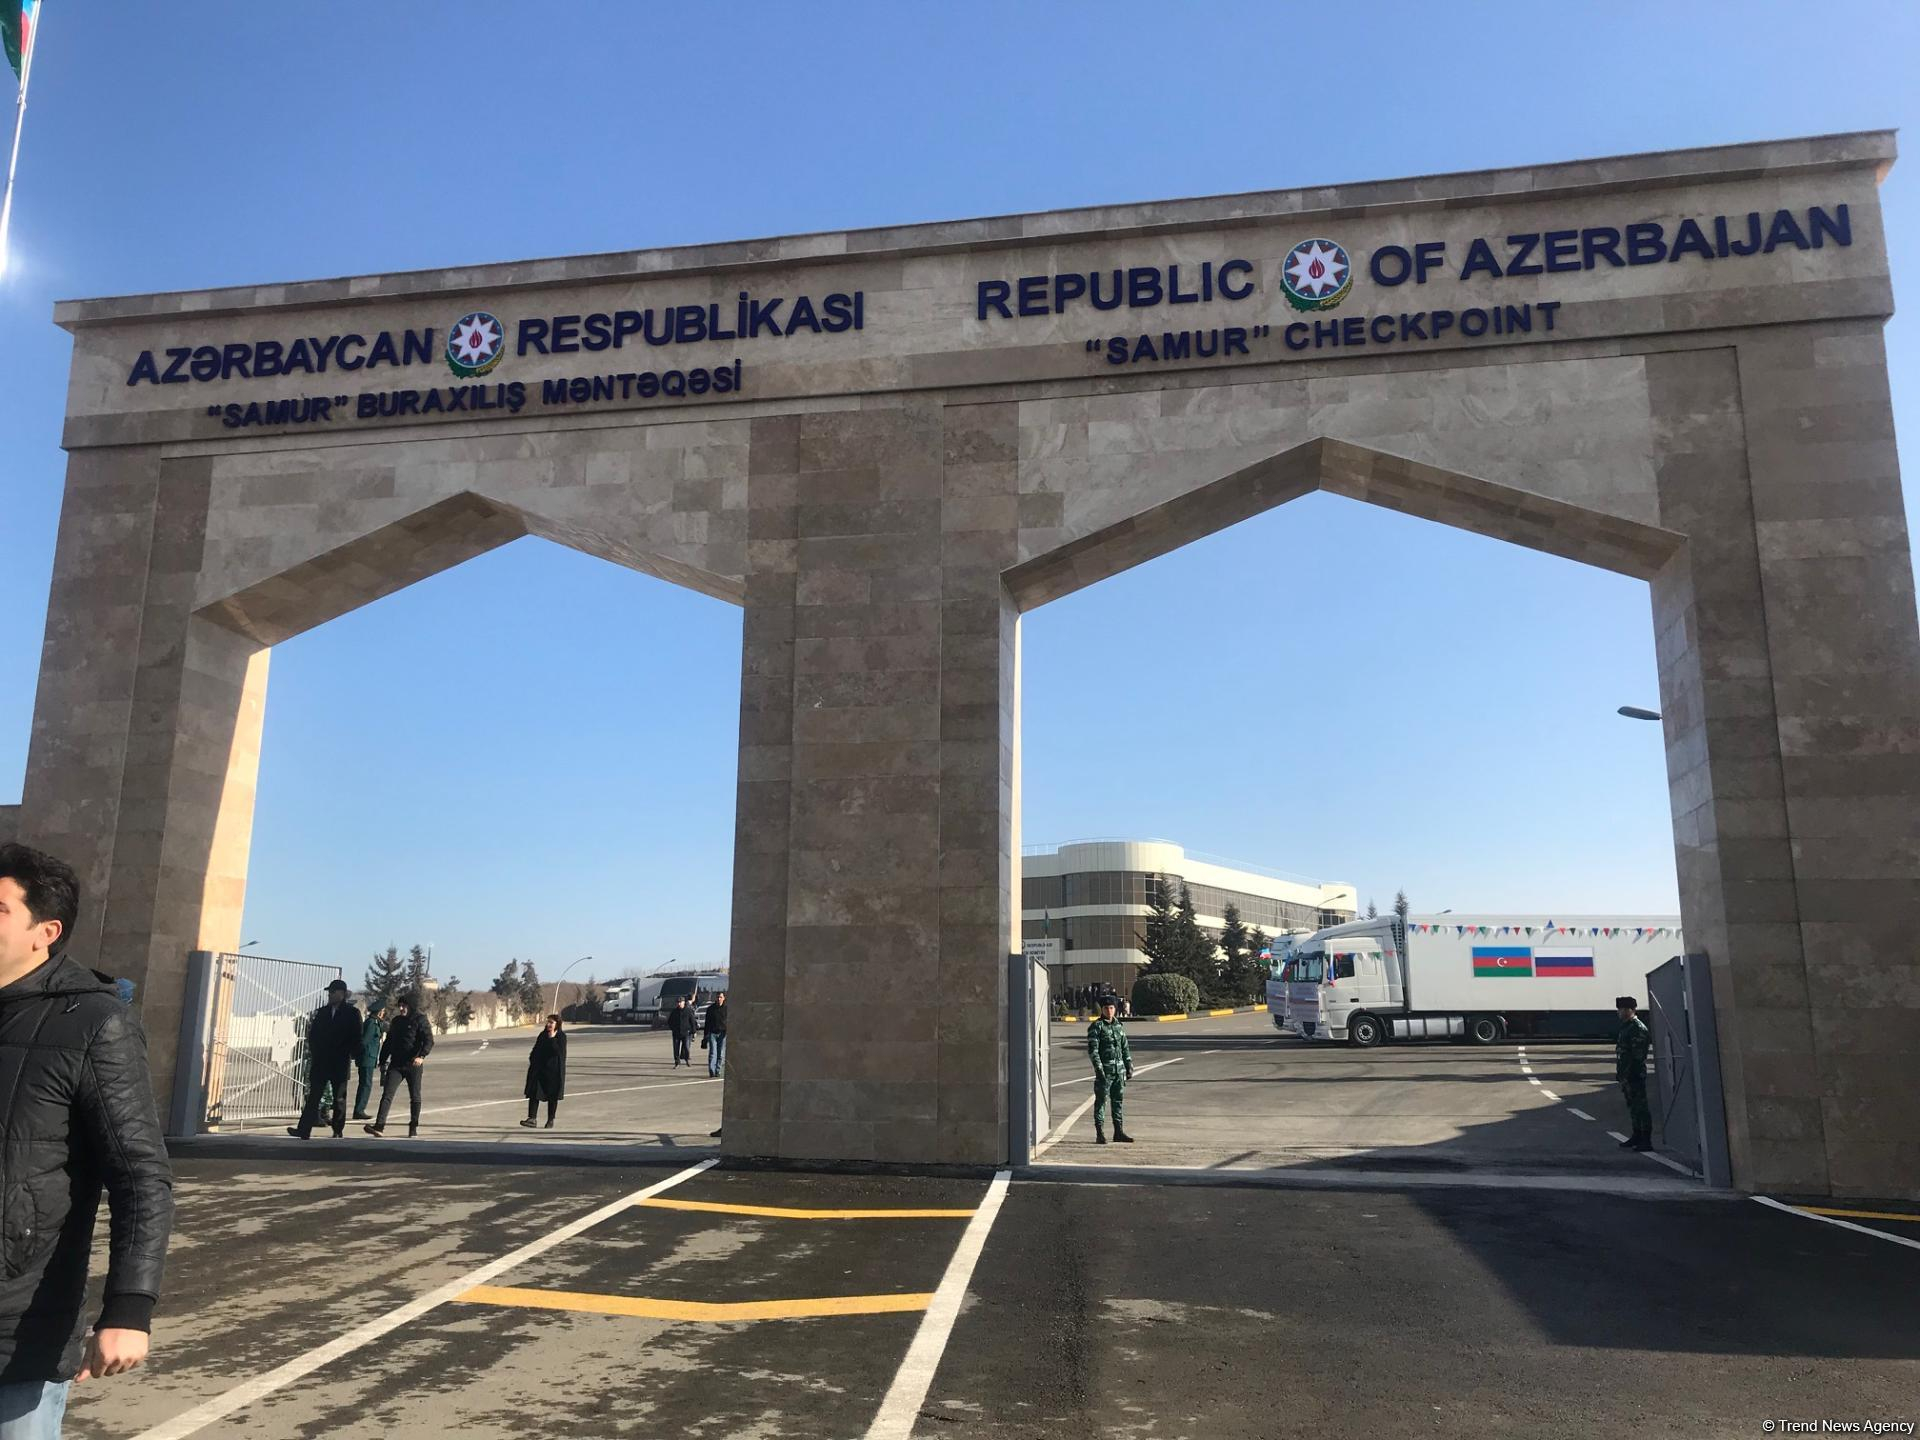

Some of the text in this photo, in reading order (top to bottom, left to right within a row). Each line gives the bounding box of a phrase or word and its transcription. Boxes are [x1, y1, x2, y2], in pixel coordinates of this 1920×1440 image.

[976, 204, 1852, 320] REPUBLIC OF AZERBAIJAN
[127, 291, 864, 386] AZƏRBAYCAN RESPUBLİKASI
[1284, 303, 1561, 350] CHECKPOINT
[357, 382, 526, 418] BURAXILIŞ
[542, 358, 742, 405] MƏNTƏQƏSİ
